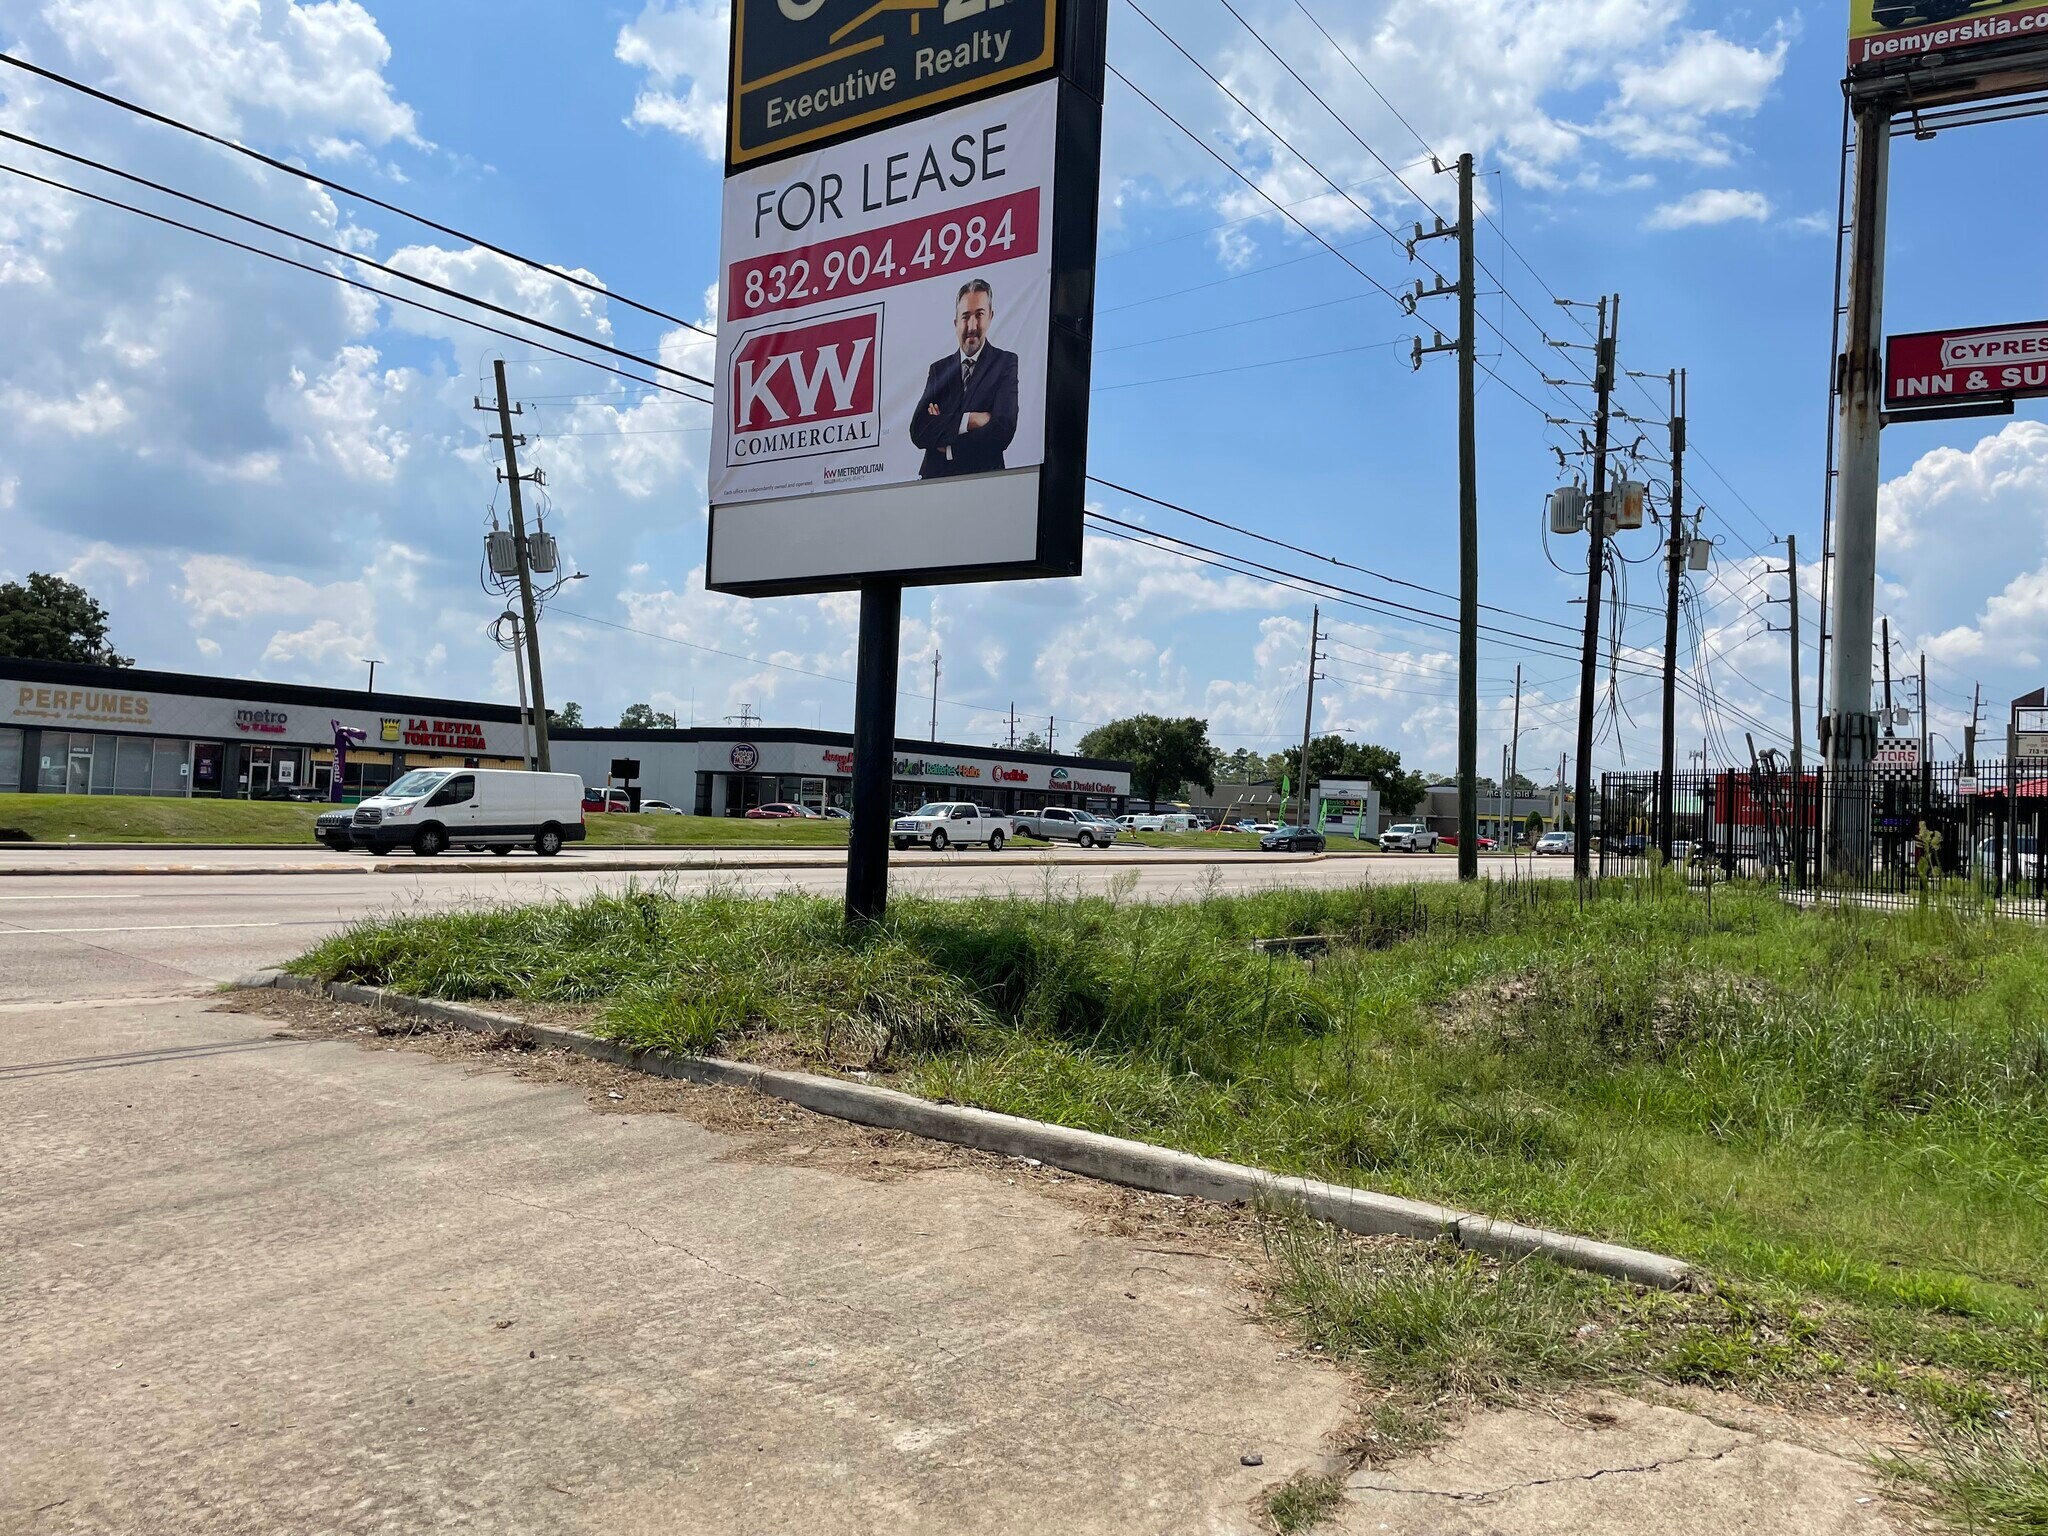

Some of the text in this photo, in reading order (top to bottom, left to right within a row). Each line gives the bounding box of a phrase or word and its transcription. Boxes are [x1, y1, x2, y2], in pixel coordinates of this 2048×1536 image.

[766, 29, 1011, 128] Executive Realty
[755, 123, 1007, 238] FOR LEASE
[744, 208, 1016, 309] 832.904.4984
[1950, 337, 2048, 360] CYPRES
[737, 337, 873, 428] KW
[1896, 365, 2046, 397] INN & SU
[734, 421, 872, 457] COMMERCIAL
[837, 463, 884, 477] METROPOLITAN
[19, 687, 149, 716] PERFUMES
[237, 709, 287, 724] metro
[409, 719, 482, 735] LA REYNA
[403, 732, 486, 750] TORTILLERIA
[1874, 751, 1916, 762] TORS
[926, 762, 957, 776] Batteries
[1003, 769, 1029, 782] edible
[1073, 780, 1095, 792] Dental
[1096, 782, 1117, 794] Center
[1486, 790, 1537, 798] Mcoald's
